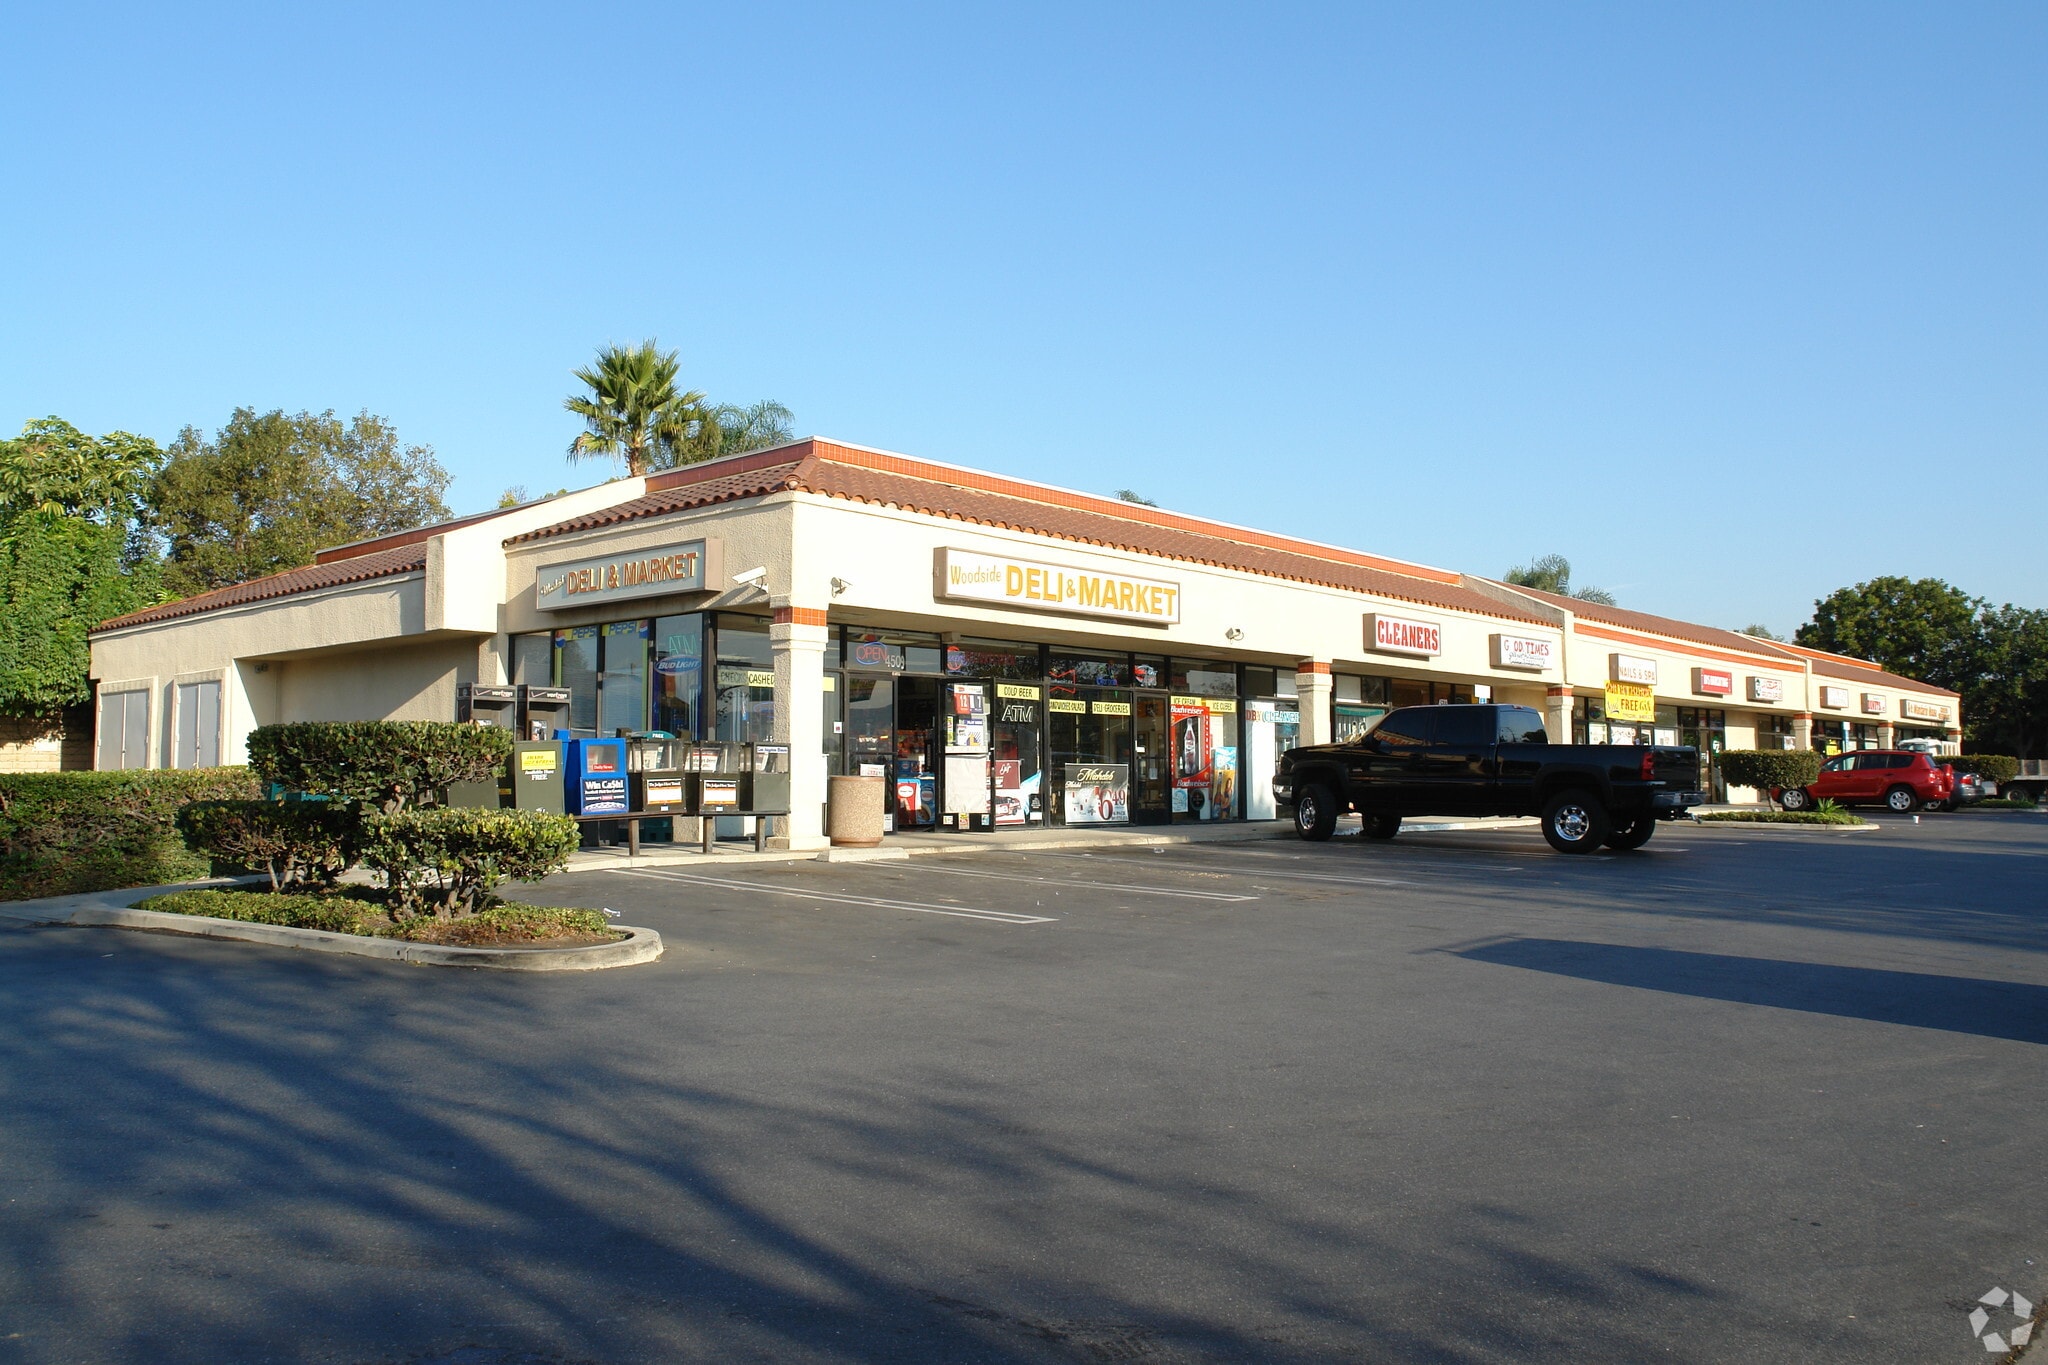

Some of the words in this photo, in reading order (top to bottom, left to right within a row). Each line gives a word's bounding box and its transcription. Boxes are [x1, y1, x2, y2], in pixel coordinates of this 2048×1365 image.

[567, 566, 604, 595] DELI
[607, 564, 620, 589] &
[623, 551, 698, 587] MARKET
[950, 564, 1001, 585] Woodside
[1006, 564, 1064, 603] DELI
[1066, 578, 1077, 598] &
[1079, 575, 1177, 616] MARKET
[609, 621, 636, 636] PEPSI
[1377, 620, 1439, 651] CLEANERS
[668, 633, 697, 655] ATM
[1526, 642, 1549, 657] TIMES
[856, 645, 887, 660] OPEN
[658, 661, 675, 671] BUD
[676, 659, 700, 670] LIGHT
[885, 654, 905, 669] 4509
[749, 674, 774, 684] CASHED
[1618, 666, 1637, 678] NAILS
[1644, 670, 1655, 681] SPA
[1004, 686, 1017, 697] COLD
[1018, 688, 1033, 698] BEER
[1170, 705, 1204, 715] Budweiser
[1620, 698, 1638, 711] FREE
[1002, 704, 1033, 722] ATM
[585, 781, 600, 789] Win
[1177, 779, 1210, 787] Budweiser
